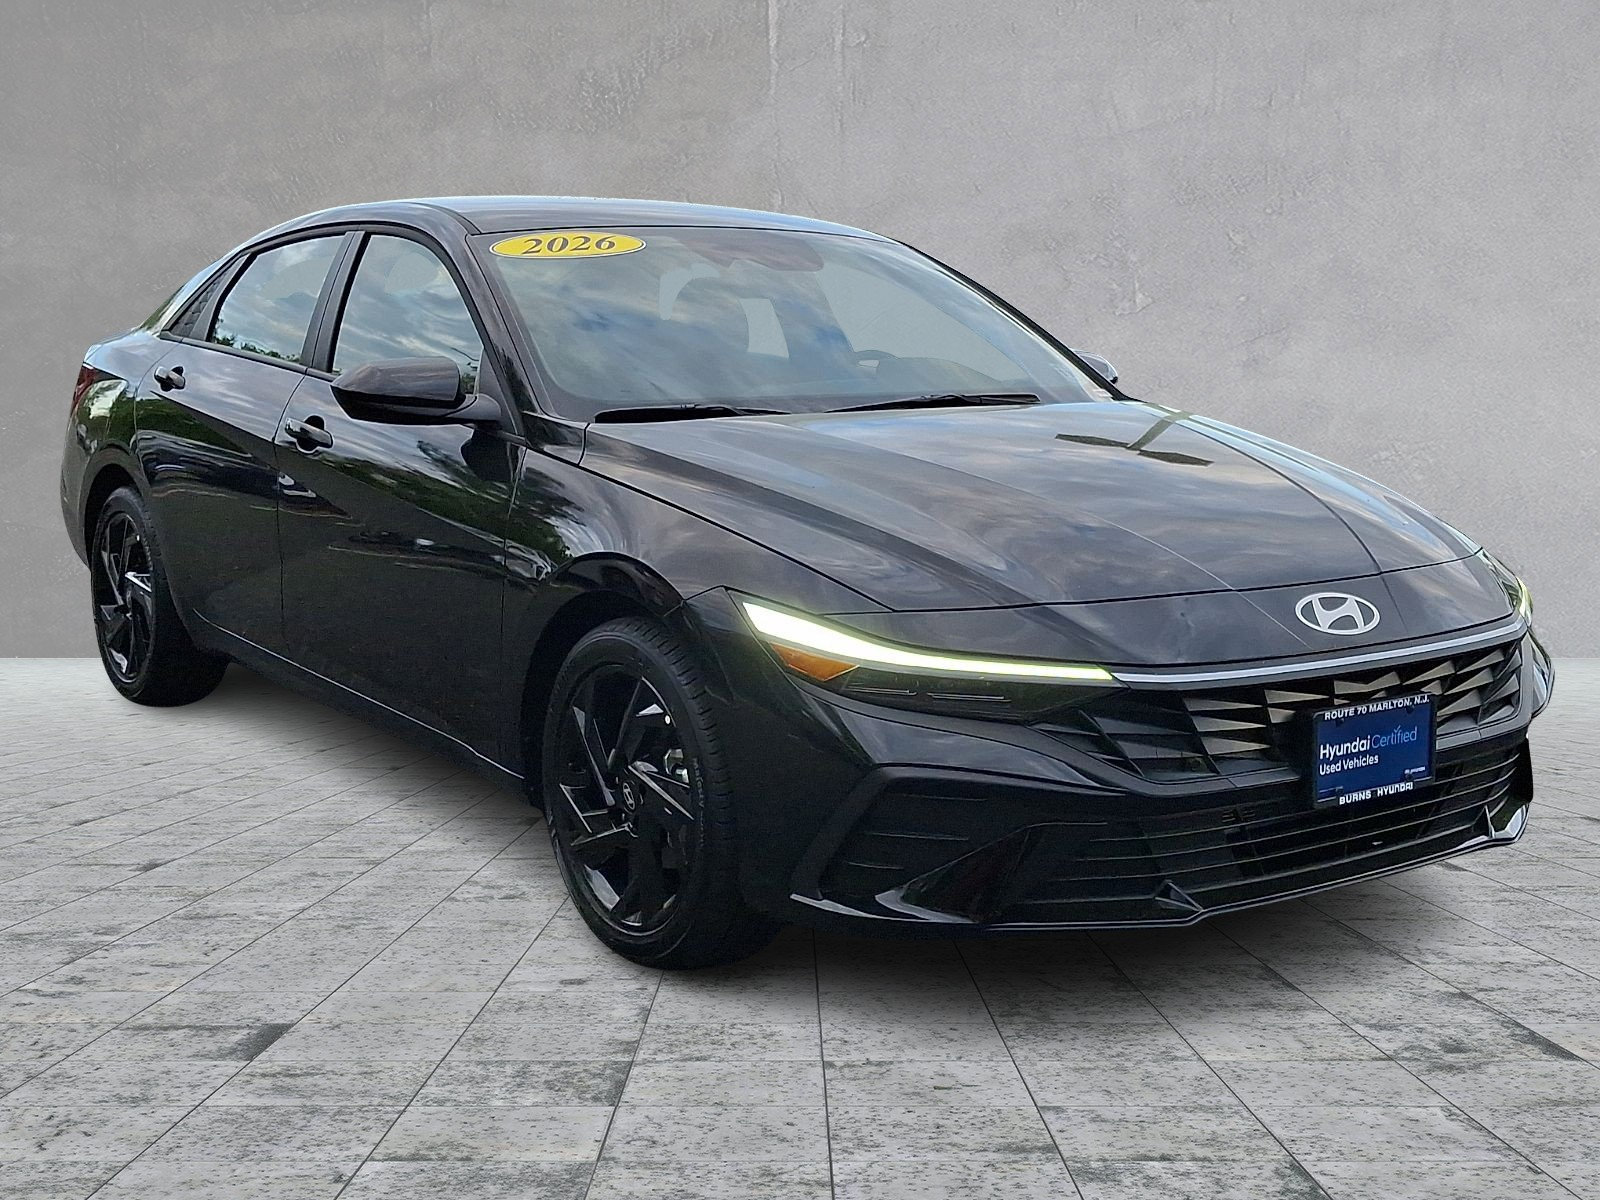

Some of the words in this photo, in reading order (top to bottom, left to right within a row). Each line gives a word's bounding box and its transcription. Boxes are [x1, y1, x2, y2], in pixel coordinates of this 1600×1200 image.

[521, 235, 617, 254] 2026
[1324, 708, 1355, 721] ROUTE
[1357, 706, 1367, 716] 70
[1414, 694, 1430, 705] N.J.
[1320, 735, 1371, 761] Hyundai
[1371, 726, 1417, 749] Certified
[1320, 759, 1342, 776] Used
[1343, 754, 1379, 770] Vehicles
[1339, 790, 1372, 805] BURNS
[1377, 781, 1414, 797] HYUNDAI
